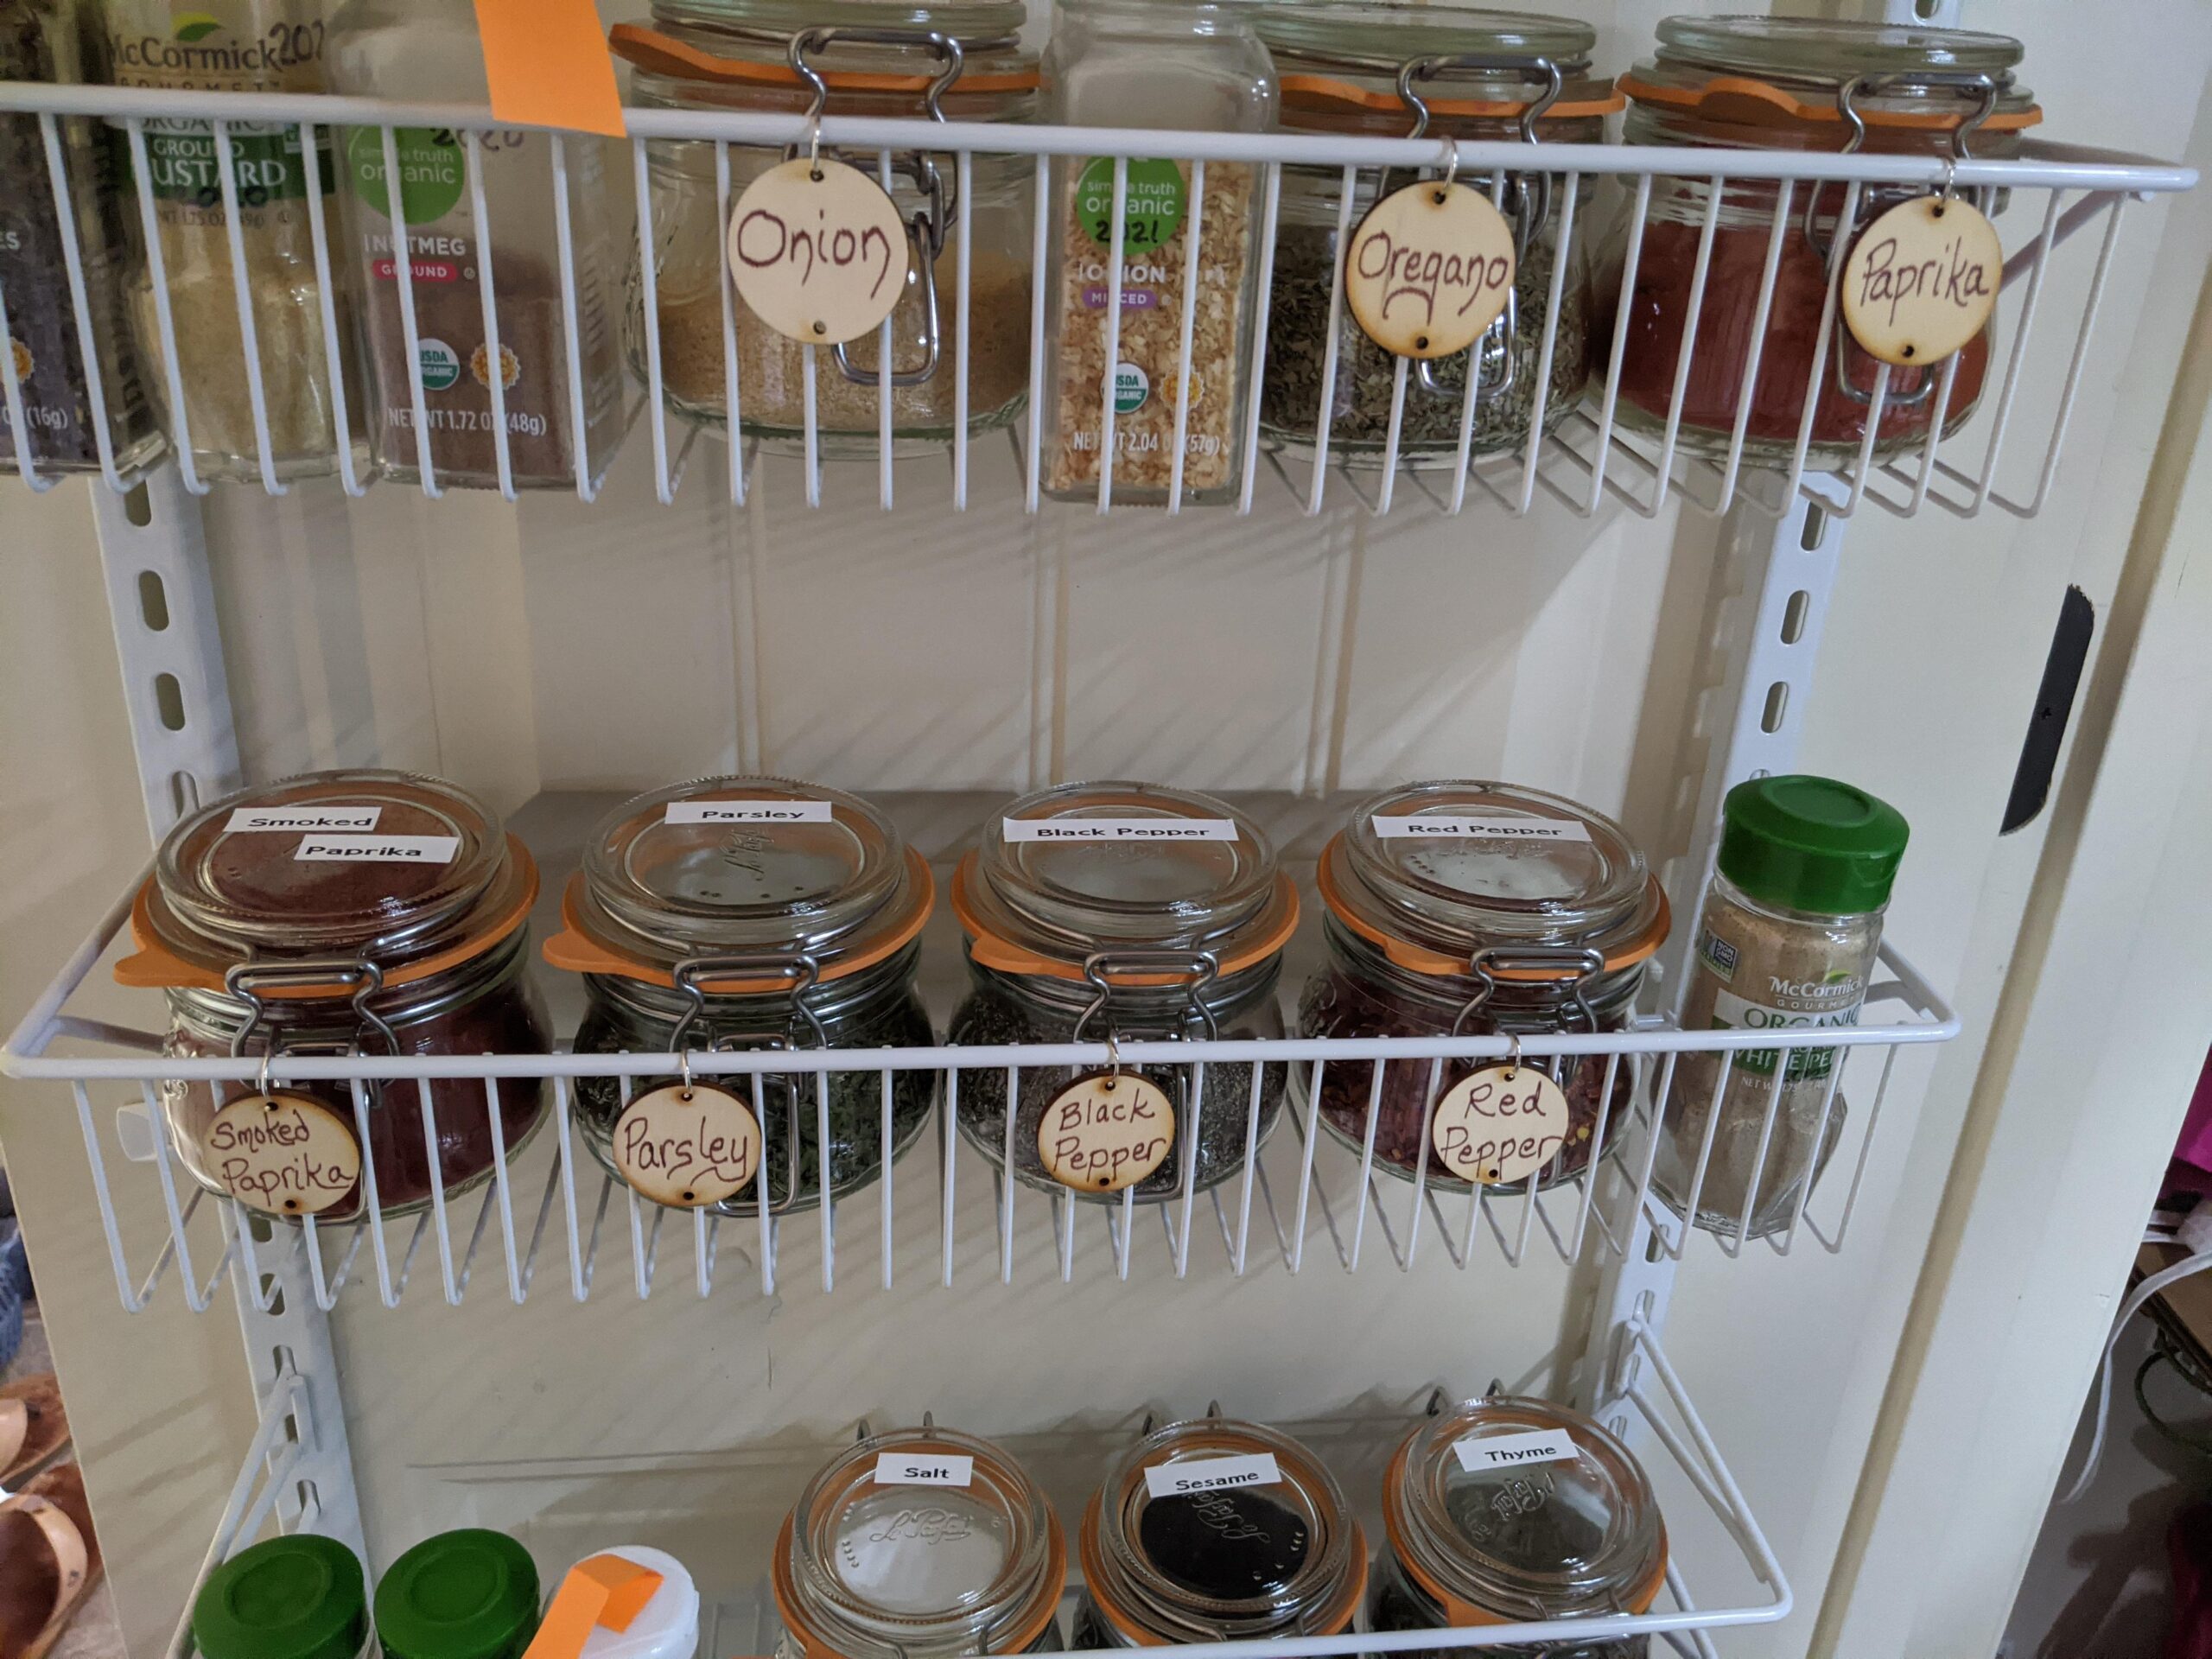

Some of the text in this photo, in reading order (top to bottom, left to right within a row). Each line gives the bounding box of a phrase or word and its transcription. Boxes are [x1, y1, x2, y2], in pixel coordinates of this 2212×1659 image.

[153, 138, 245, 158] GROUD
[150, 159, 288, 188] USTRD
[360, 162, 456, 184] oranic
[1139, 181, 1176, 195] truth
[1085, 195, 1175, 216] oranic
[1096, 219, 1159, 244] 221
[372, 234, 467, 257] NTMEG
[737, 209, 891, 300] Onion
[1085, 263, 1166, 283] OION
[1358, 230, 1510, 327] Oregano
[1860, 236, 1989, 327] Paprika
[1091, 292, 1147, 305] MICED
[1116, 374, 1139, 387] SDA
[26, 406, 68, 430] (16g)
[447, 410, 478, 431] 1.72
[1128, 433, 1159, 452] 2.04
[247, 817, 372, 828] Smoked
[702, 810, 805, 819] Parsley
[1037, 827, 1211, 837] Black Pepper
[1408, 824, 1562, 836] Red Pepper
[305, 845, 422, 858] Paprika
[1058, 1088, 1156, 1131] Black
[1465, 1080, 1546, 1119] Red
[211, 1109, 310, 1153] Smoked
[624, 1116, 747, 1186] Parsley
[1053, 1136, 1166, 1183] Pepper
[1440, 1126, 1563, 1180] Pepper
[222, 1153, 354, 1207] Paprika
[1484, 1445, 1557, 1462] Thyme
[904, 1467, 950, 1478] Salt
[1175, 1471, 1259, 1491] Sesame
